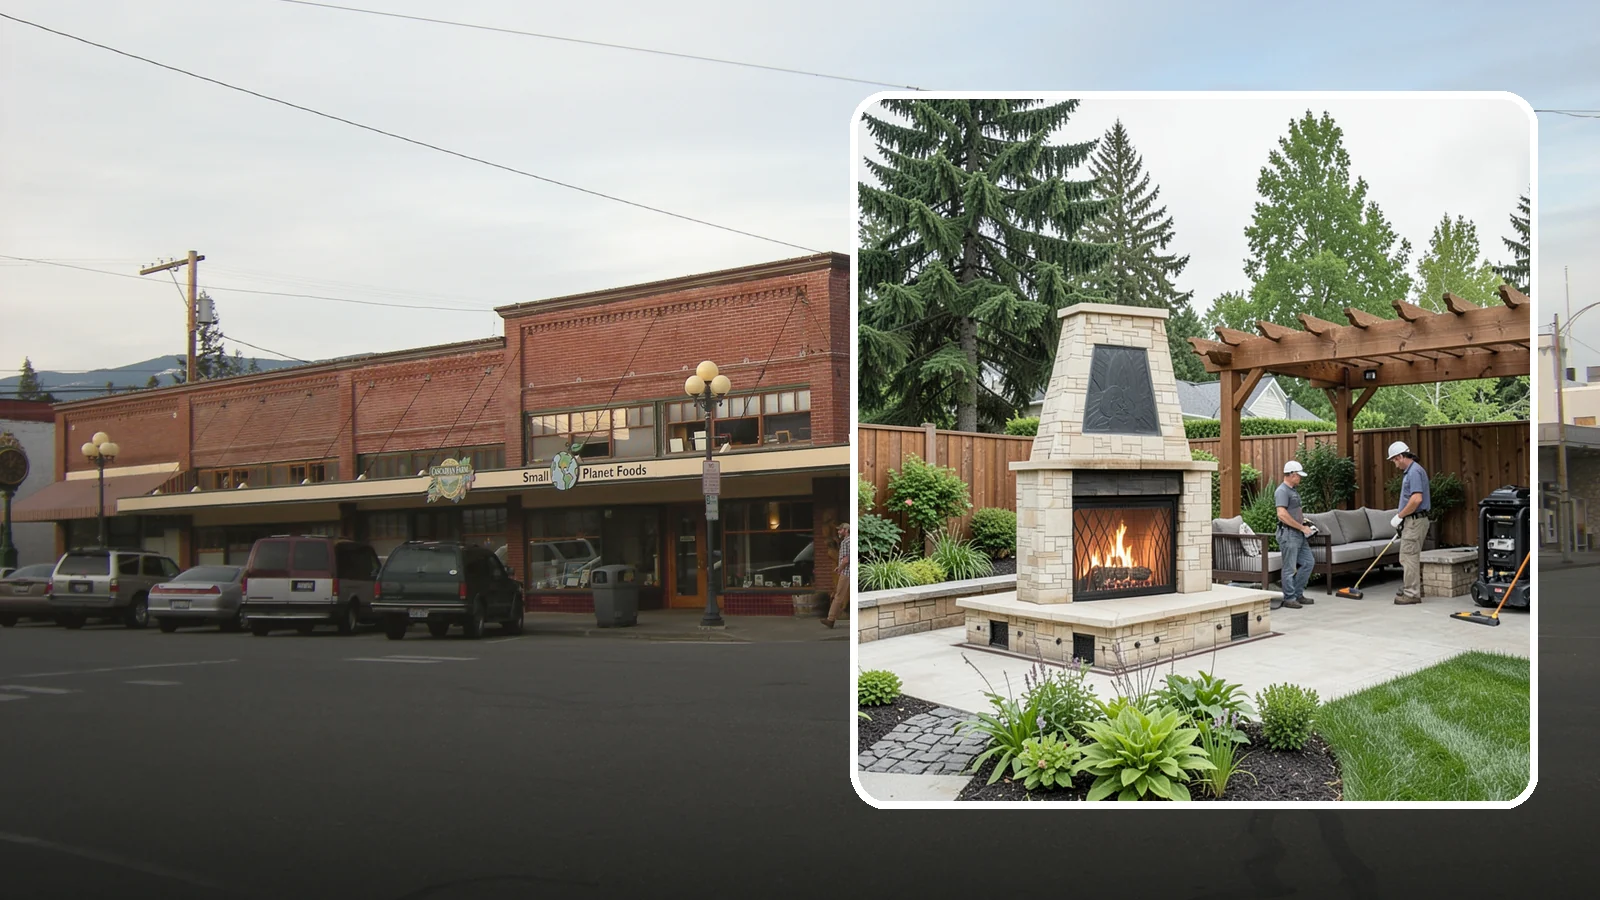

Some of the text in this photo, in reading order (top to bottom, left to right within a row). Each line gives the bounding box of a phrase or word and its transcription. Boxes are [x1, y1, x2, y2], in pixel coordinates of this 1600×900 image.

[523, 464, 647, 483] Small Planet Foods
